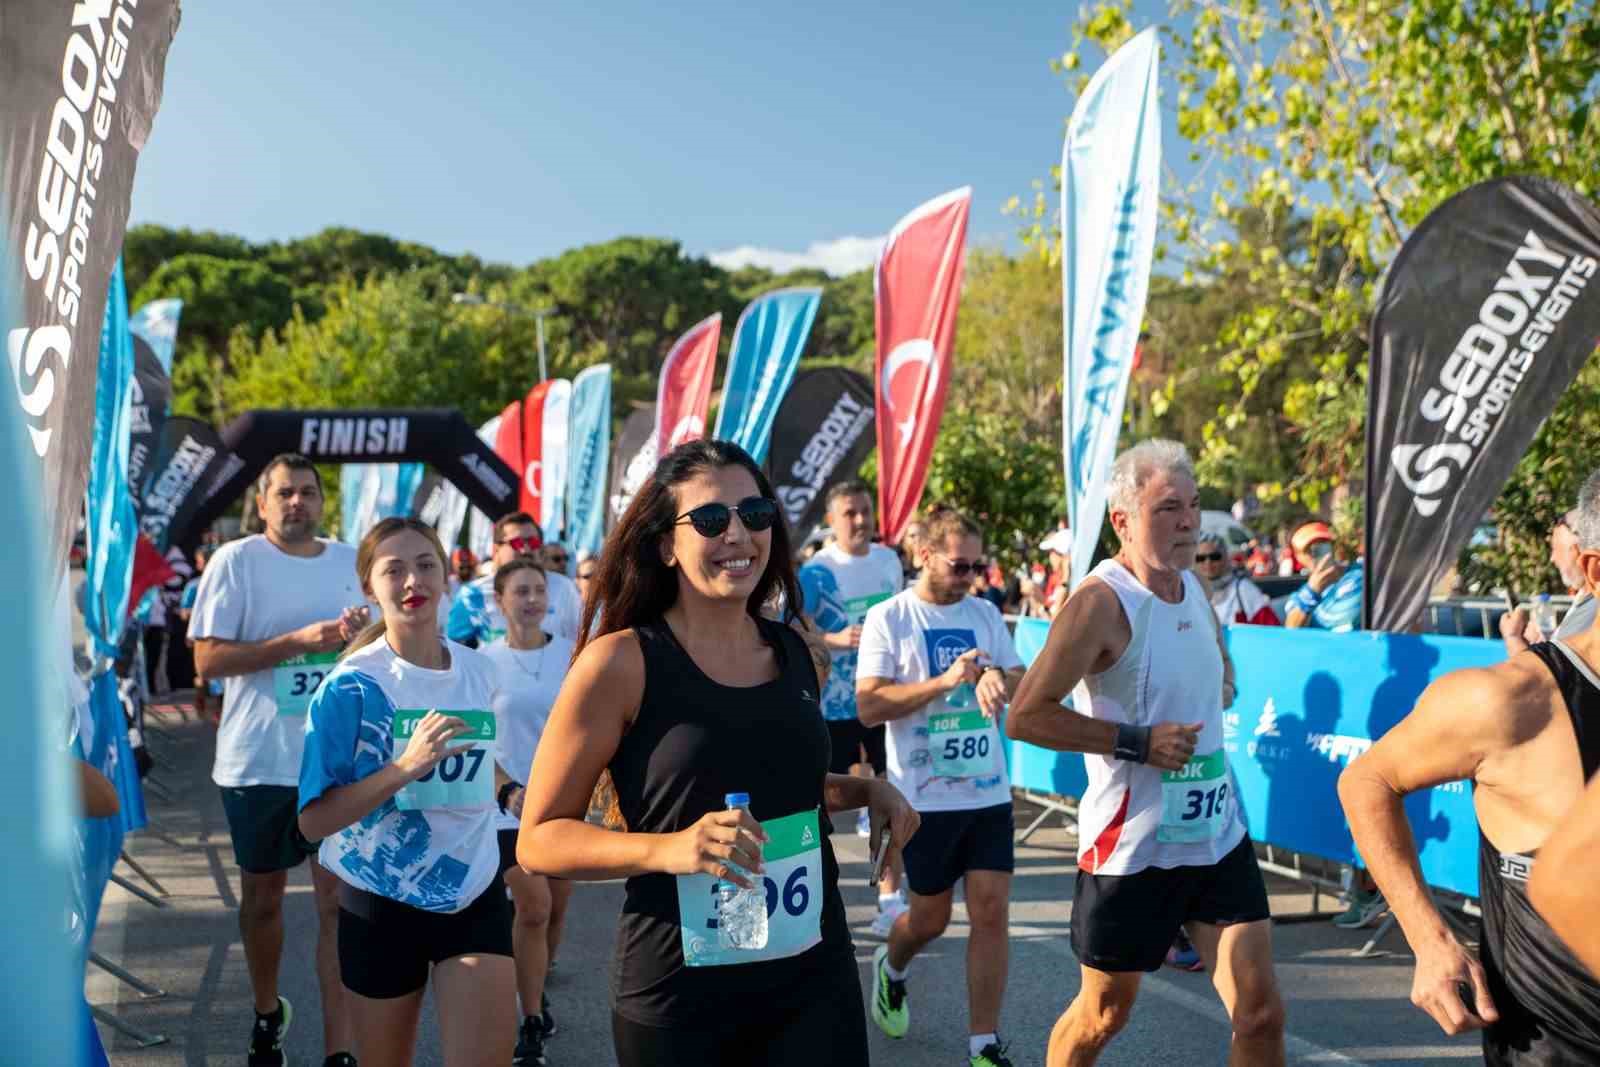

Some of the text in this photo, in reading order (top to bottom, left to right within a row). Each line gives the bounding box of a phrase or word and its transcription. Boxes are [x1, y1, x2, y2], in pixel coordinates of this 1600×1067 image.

[58, 139, 103, 327] SPORTS
[93, 0, 138, 141] EVEN
[1420, 229, 1566, 433] SEDOXY
[1459, 254, 1598, 447] SPORTS EVENTS
[301, 416, 408, 455] FINISH
[792, 392, 861, 483] SEDOXY
[291, 671, 331, 696] 32
[933, 718, 961, 731] 10K
[416, 749, 487, 783] 07
[943, 734, 989, 760] 580
[1181, 783, 1227, 820] 318
